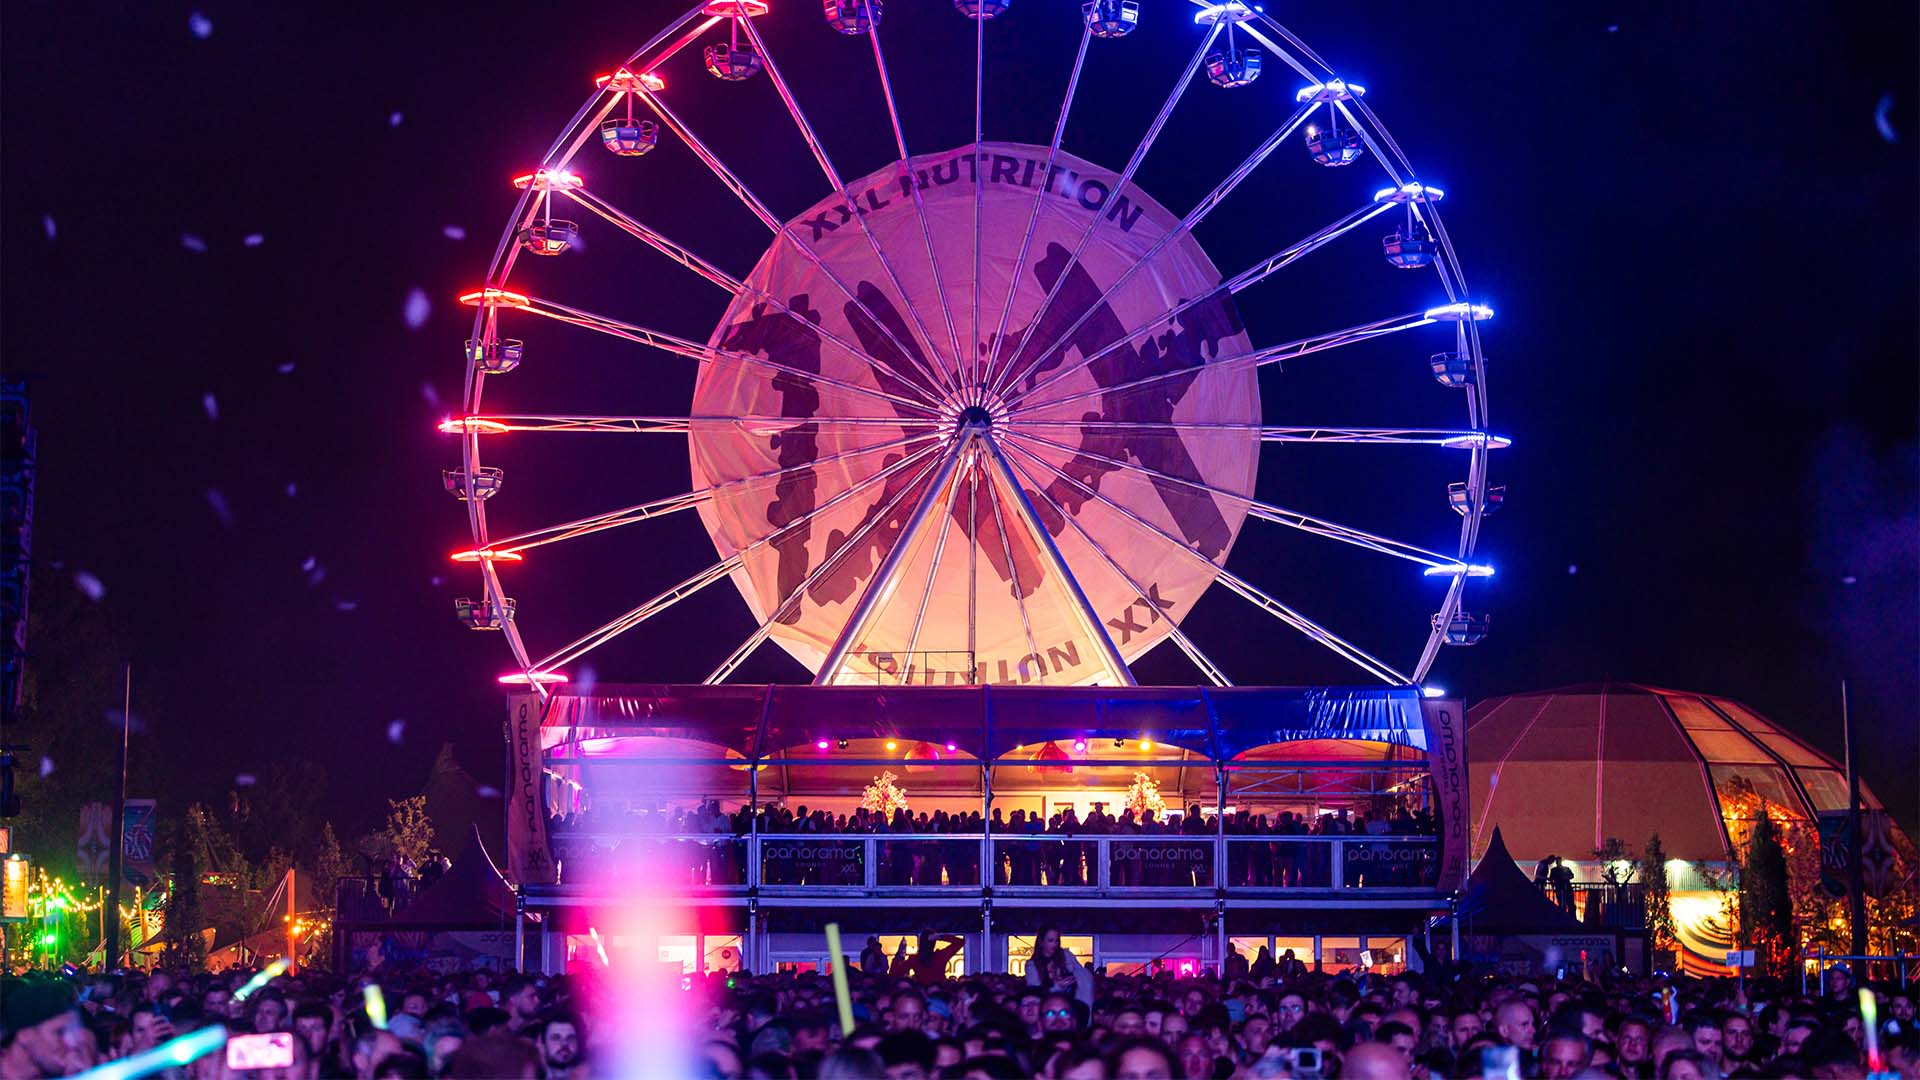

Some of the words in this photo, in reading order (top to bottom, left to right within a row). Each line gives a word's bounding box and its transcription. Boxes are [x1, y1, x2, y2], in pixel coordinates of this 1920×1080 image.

[799, 187, 891, 243] XXL
[900, 152, 1145, 233] NUTRITION
[1106, 582, 1176, 645] XX
[766, 847, 856, 860] panorama
[1114, 848, 1204, 861] panorama
[1347, 848, 1438, 862] panorama
